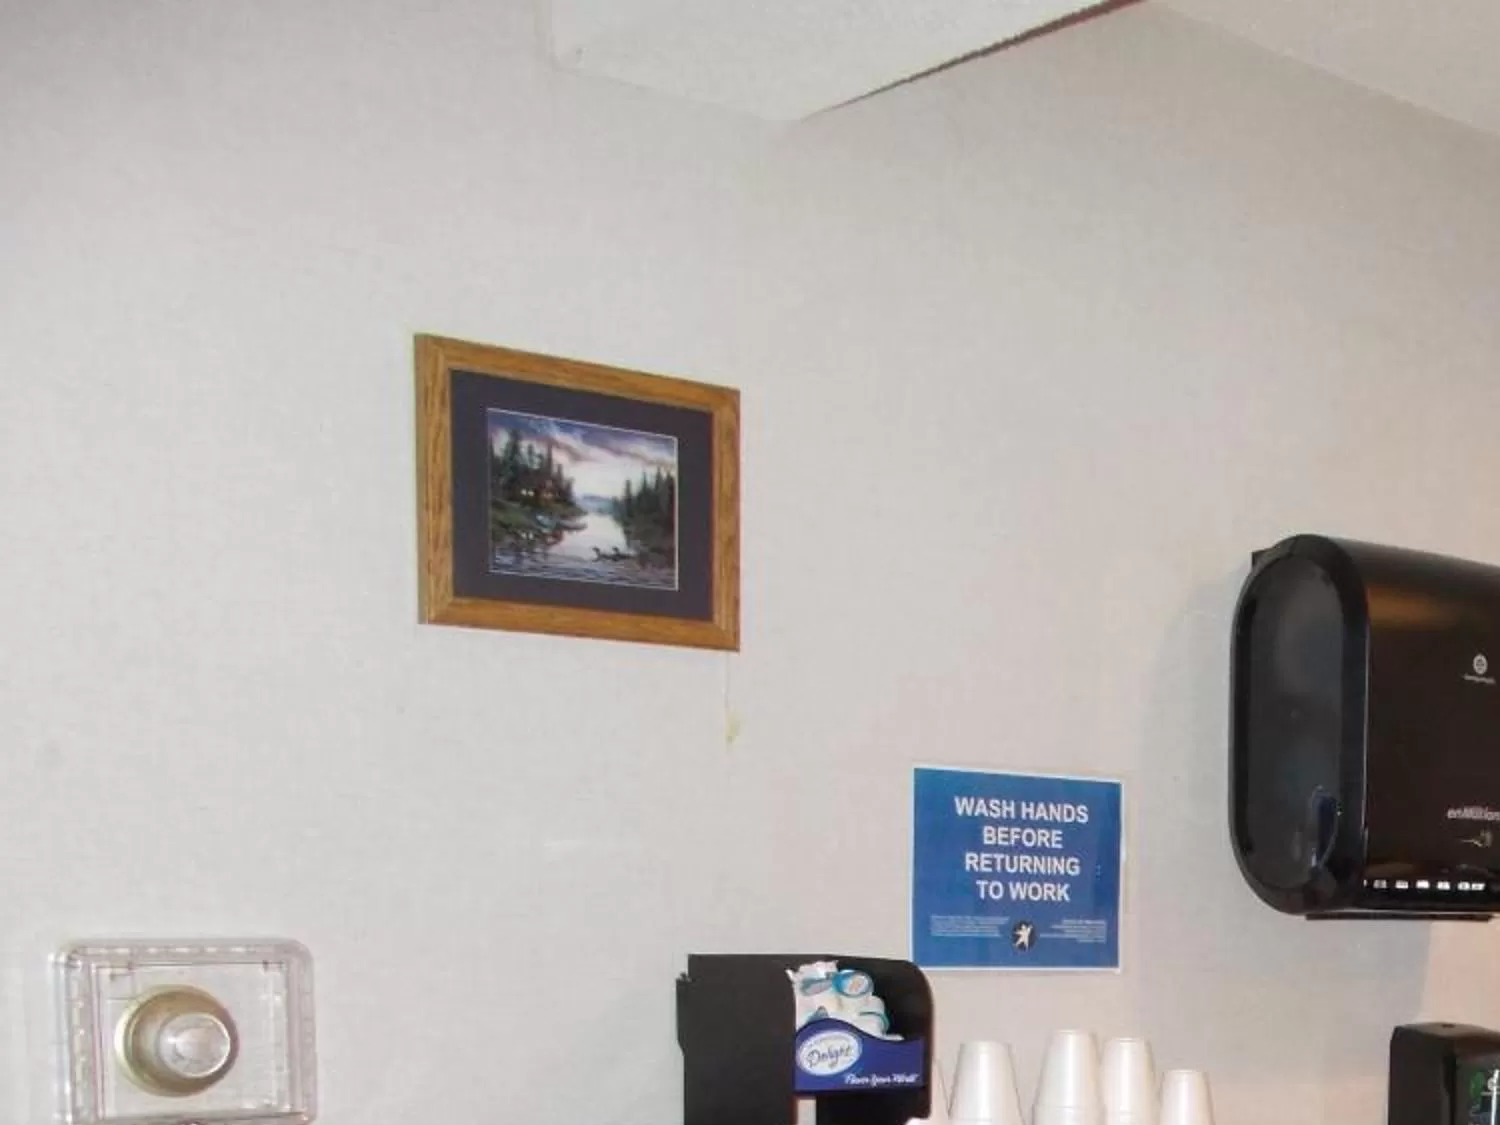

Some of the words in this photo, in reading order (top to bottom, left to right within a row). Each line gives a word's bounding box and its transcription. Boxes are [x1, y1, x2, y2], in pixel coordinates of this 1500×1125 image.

[954, 796, 1015, 819] WASH
[1021, 802, 1089, 824] HANDS
[983, 826, 1063, 848] BEFORE
[965, 852, 1081, 876] RETURNING
[976, 880, 1004, 899] TO
[1009, 882, 1071, 902] WORK
